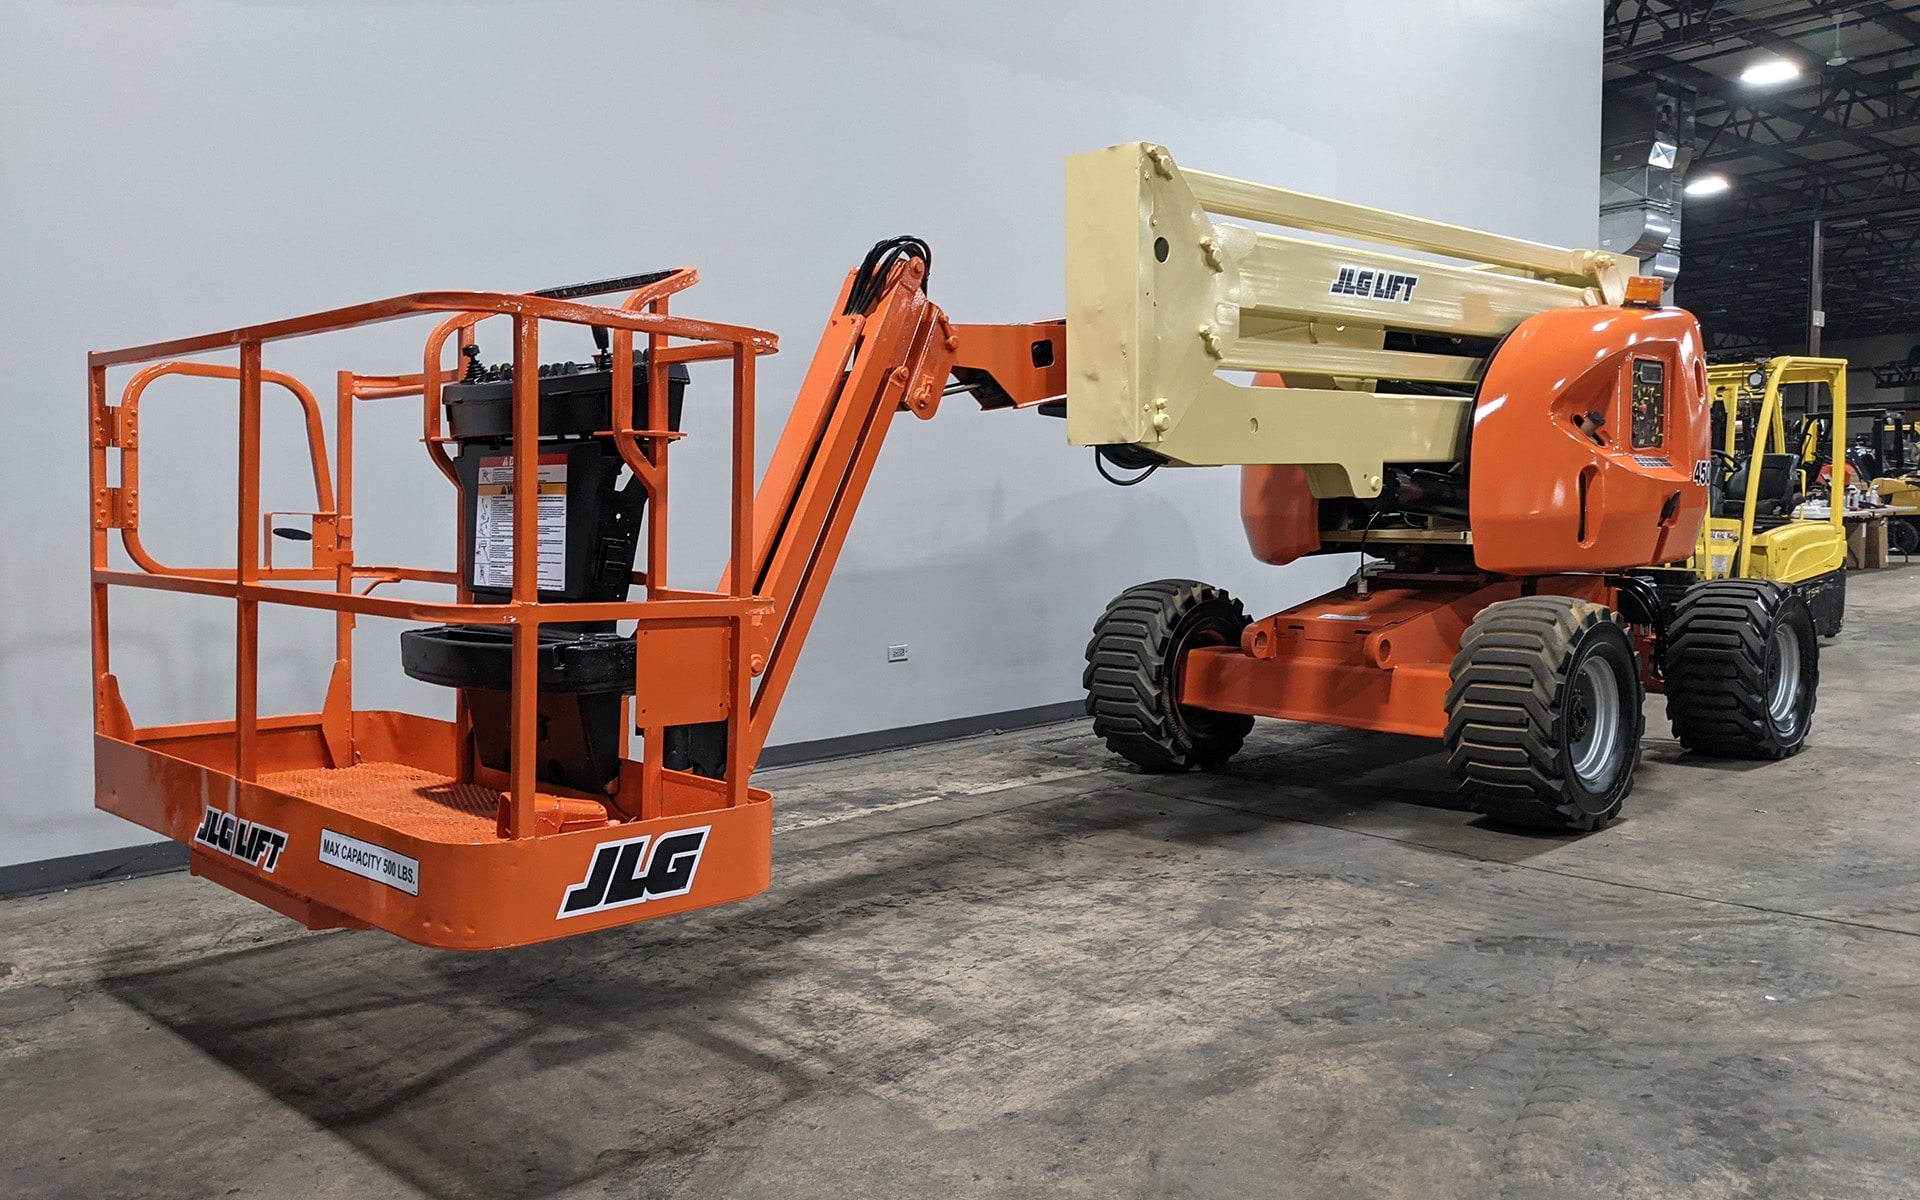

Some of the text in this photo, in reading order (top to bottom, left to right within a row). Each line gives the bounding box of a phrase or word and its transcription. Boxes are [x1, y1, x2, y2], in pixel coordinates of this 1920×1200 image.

[1330, 267, 1418, 302] JLG LIFT
[196, 808, 287, 870] JLG LIFT
[321, 838, 416, 885] MAX CAPACITY 500 LBS.
[560, 829, 708, 915] JLG
